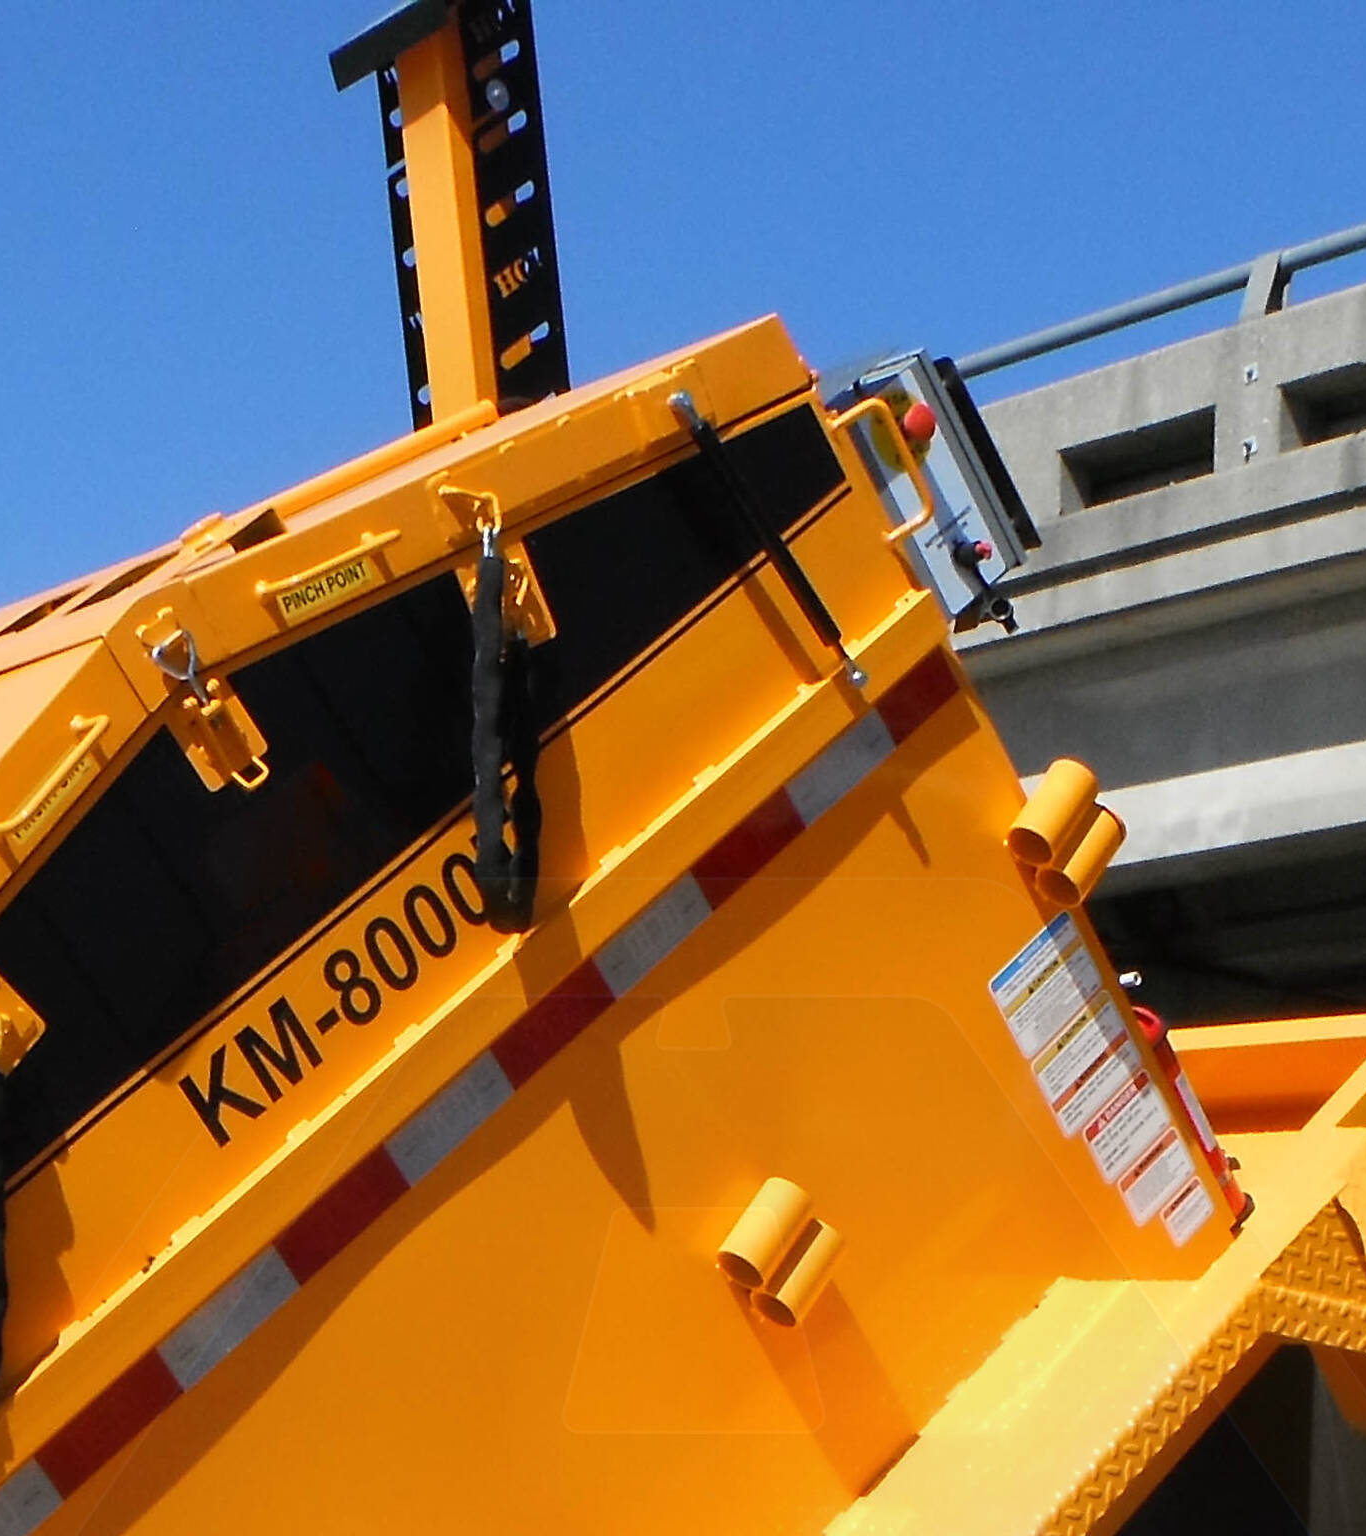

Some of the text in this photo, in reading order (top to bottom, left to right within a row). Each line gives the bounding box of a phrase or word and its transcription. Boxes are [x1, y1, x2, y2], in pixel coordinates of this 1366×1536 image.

[281, 562, 366, 613] PINCH POINT
[178, 834, 488, 1148] KM-8000
